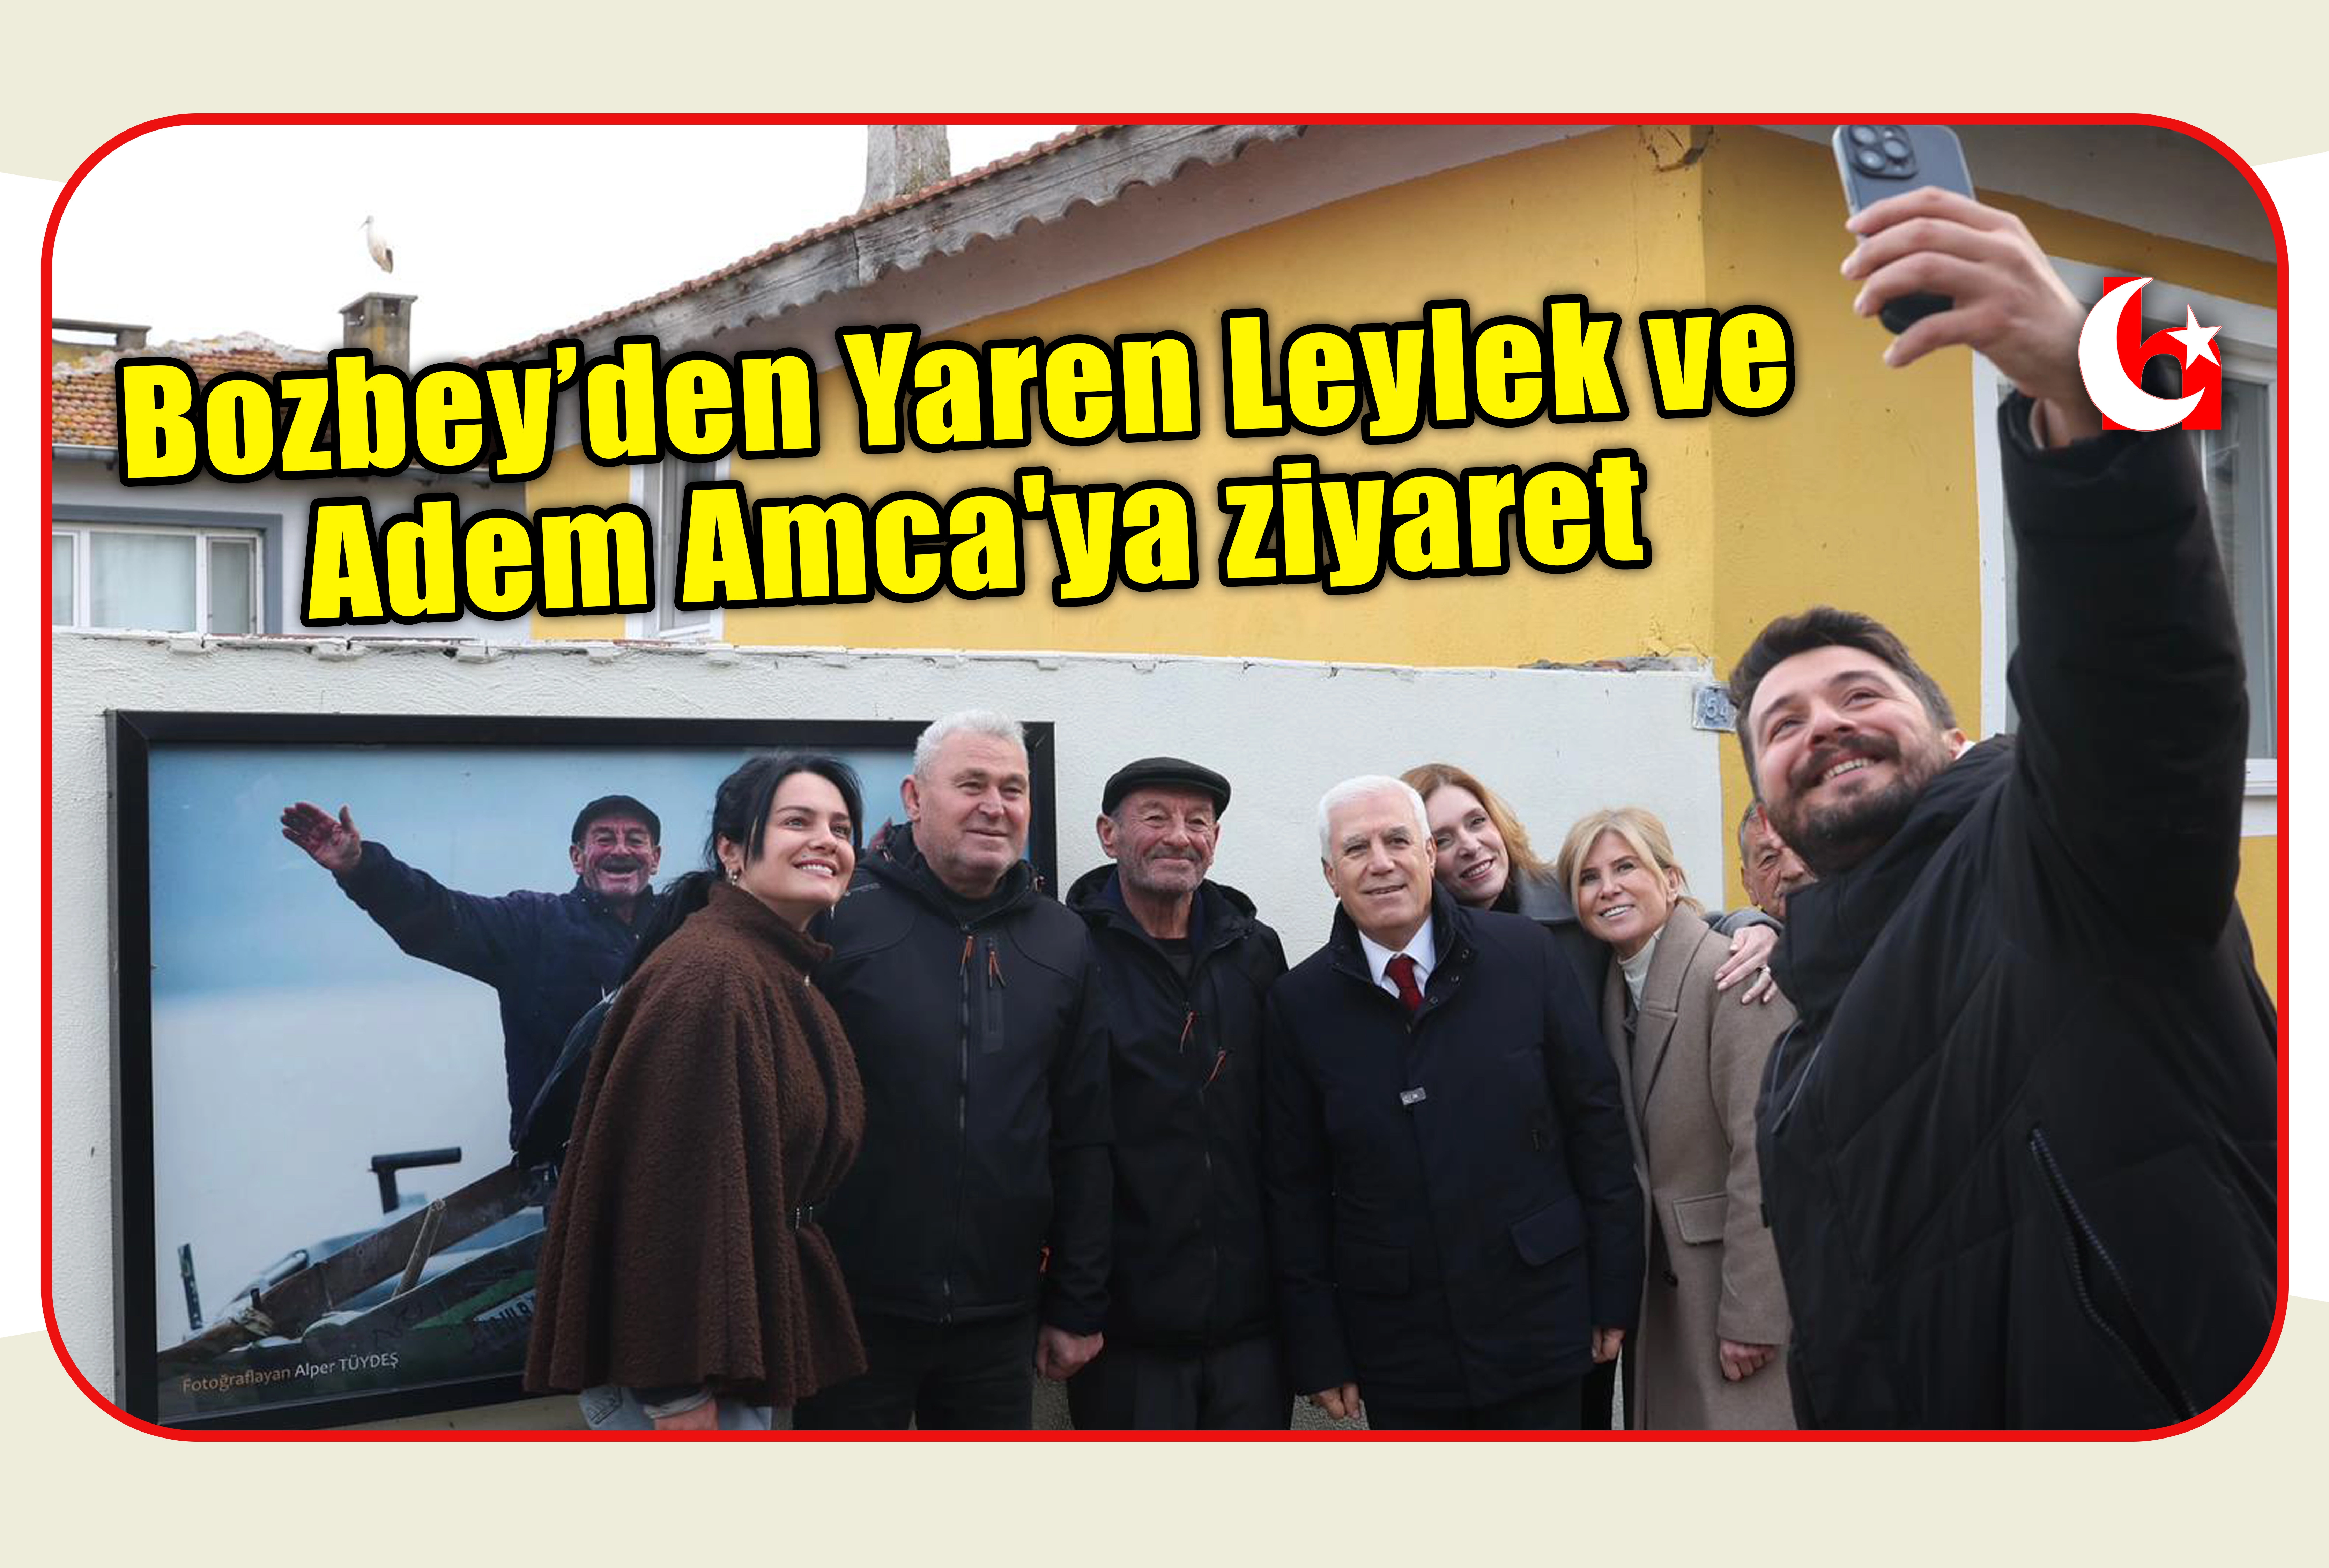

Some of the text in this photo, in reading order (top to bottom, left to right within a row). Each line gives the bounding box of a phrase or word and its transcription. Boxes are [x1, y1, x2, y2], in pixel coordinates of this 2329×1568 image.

[182, 1352, 399, 1393] Fotoğraflayan Alper TÜYDEŞ
